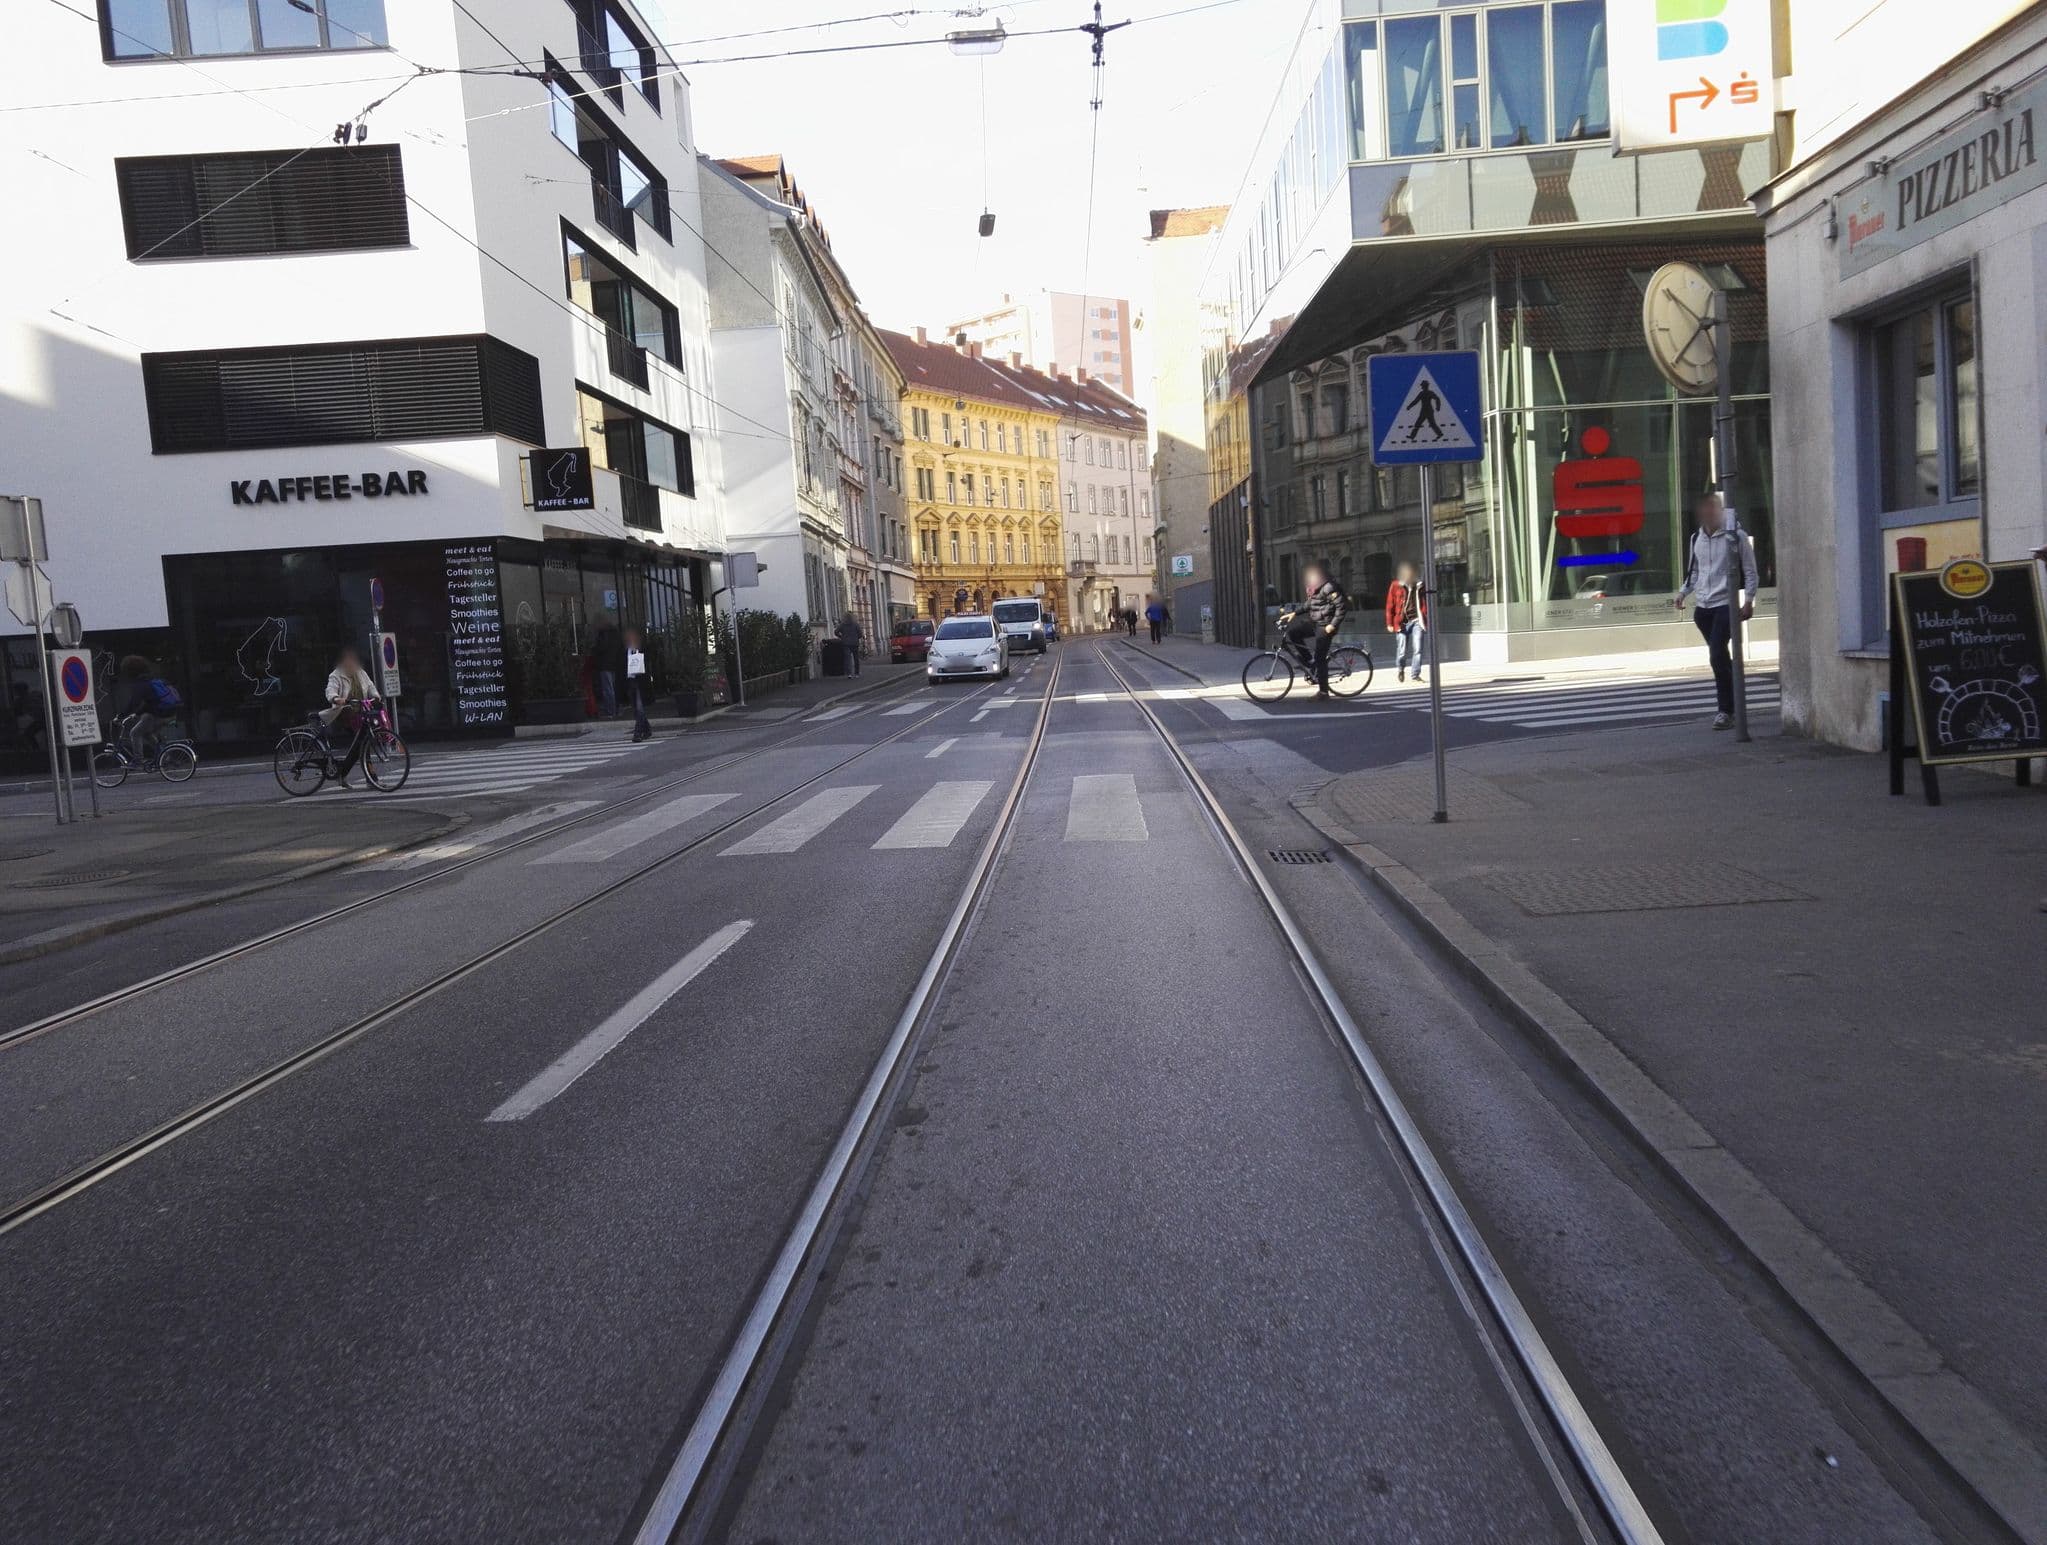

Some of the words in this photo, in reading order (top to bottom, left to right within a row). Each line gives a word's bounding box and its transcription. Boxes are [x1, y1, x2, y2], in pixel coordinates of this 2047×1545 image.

[1896, 108, 2037, 231] PIZZERIA
[231, 470, 429, 504] KAFFEE-BAR
[445, 546, 467, 555] meet
[476, 545, 492, 553] eat
[446, 568, 473, 577] Coffee
[484, 568, 495, 576] go
[449, 593, 497, 605] Tagesteller
[450, 608, 499, 618] Smoothies
[451, 620, 500, 634] Weine
[453, 636, 476, 645] meet
[485, 635, 500, 643] eat
[1950, 629, 2026, 645] Mitnehmen
[455, 659, 482, 667] Coffee
[492, 659, 503, 667] go
[458, 684, 505, 695] Tagesteller
[459, 699, 507, 709] Smoothies
[465, 711, 503, 723] W-LAN
